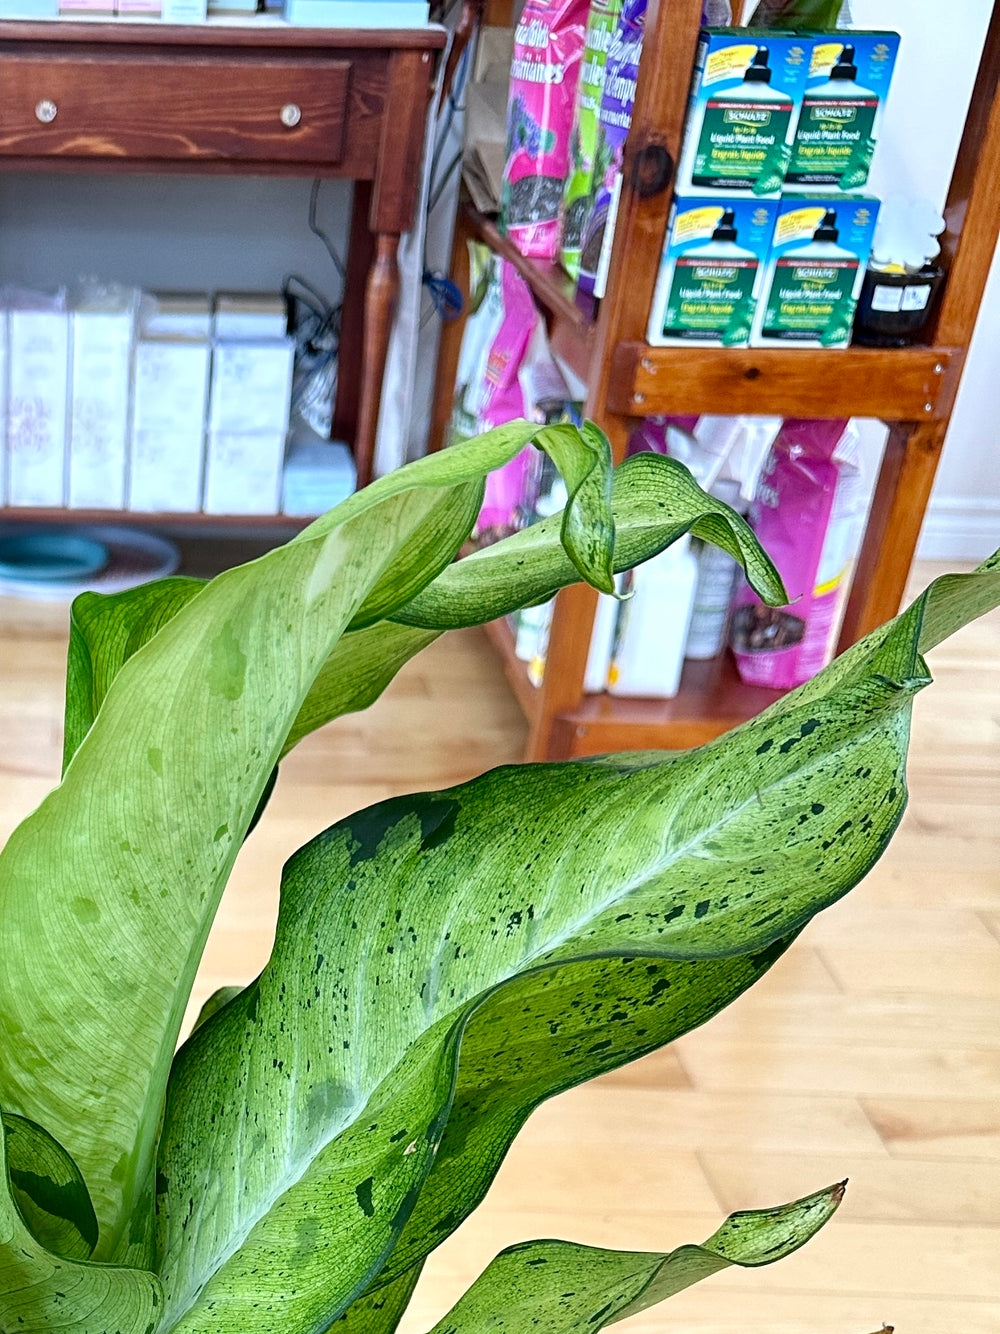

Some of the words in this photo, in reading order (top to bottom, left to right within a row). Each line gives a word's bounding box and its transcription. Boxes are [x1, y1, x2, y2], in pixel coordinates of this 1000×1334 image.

[728, 110, 768, 121] SCHULTZ
[815, 108, 853, 118] SCHULTZ
[710, 132, 734, 145] Liquid
[735, 133, 755, 144] Plant
[756, 133, 775, 145] Food
[797, 129, 820, 142] Liquid
[821, 130, 840, 140] Plant
[841, 130, 861, 141] Food
